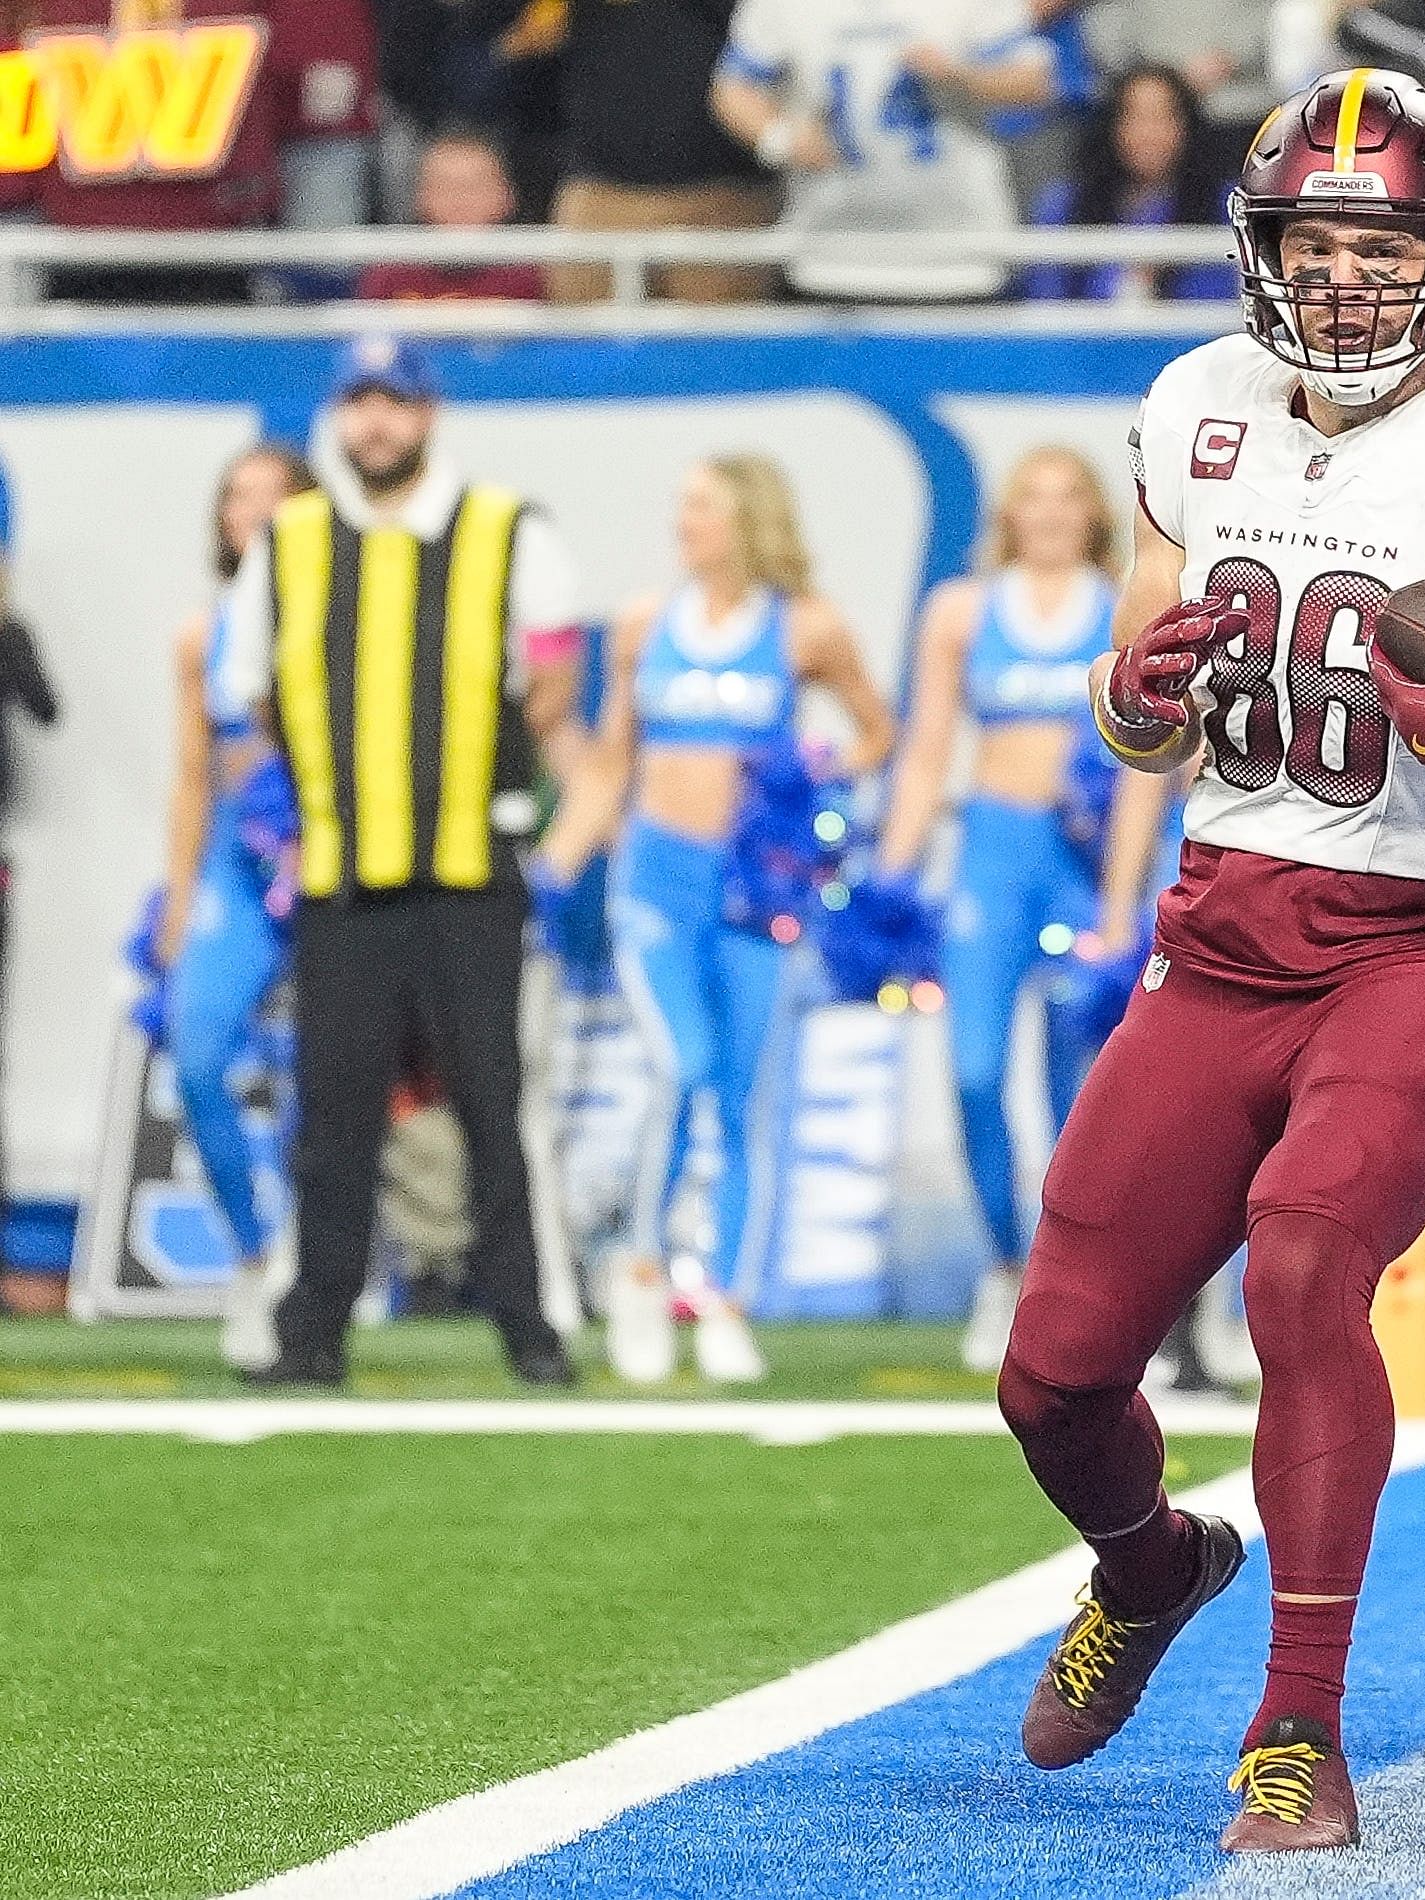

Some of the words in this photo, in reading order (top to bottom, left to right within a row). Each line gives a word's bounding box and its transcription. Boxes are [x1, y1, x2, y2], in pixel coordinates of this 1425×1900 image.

[1311, 180, 1374, 191] COMMANDERS
[1194, 421, 1242, 465] C
[1215, 525, 1399, 560] WASHINGTON
[1204, 556, 1392, 808] 86
